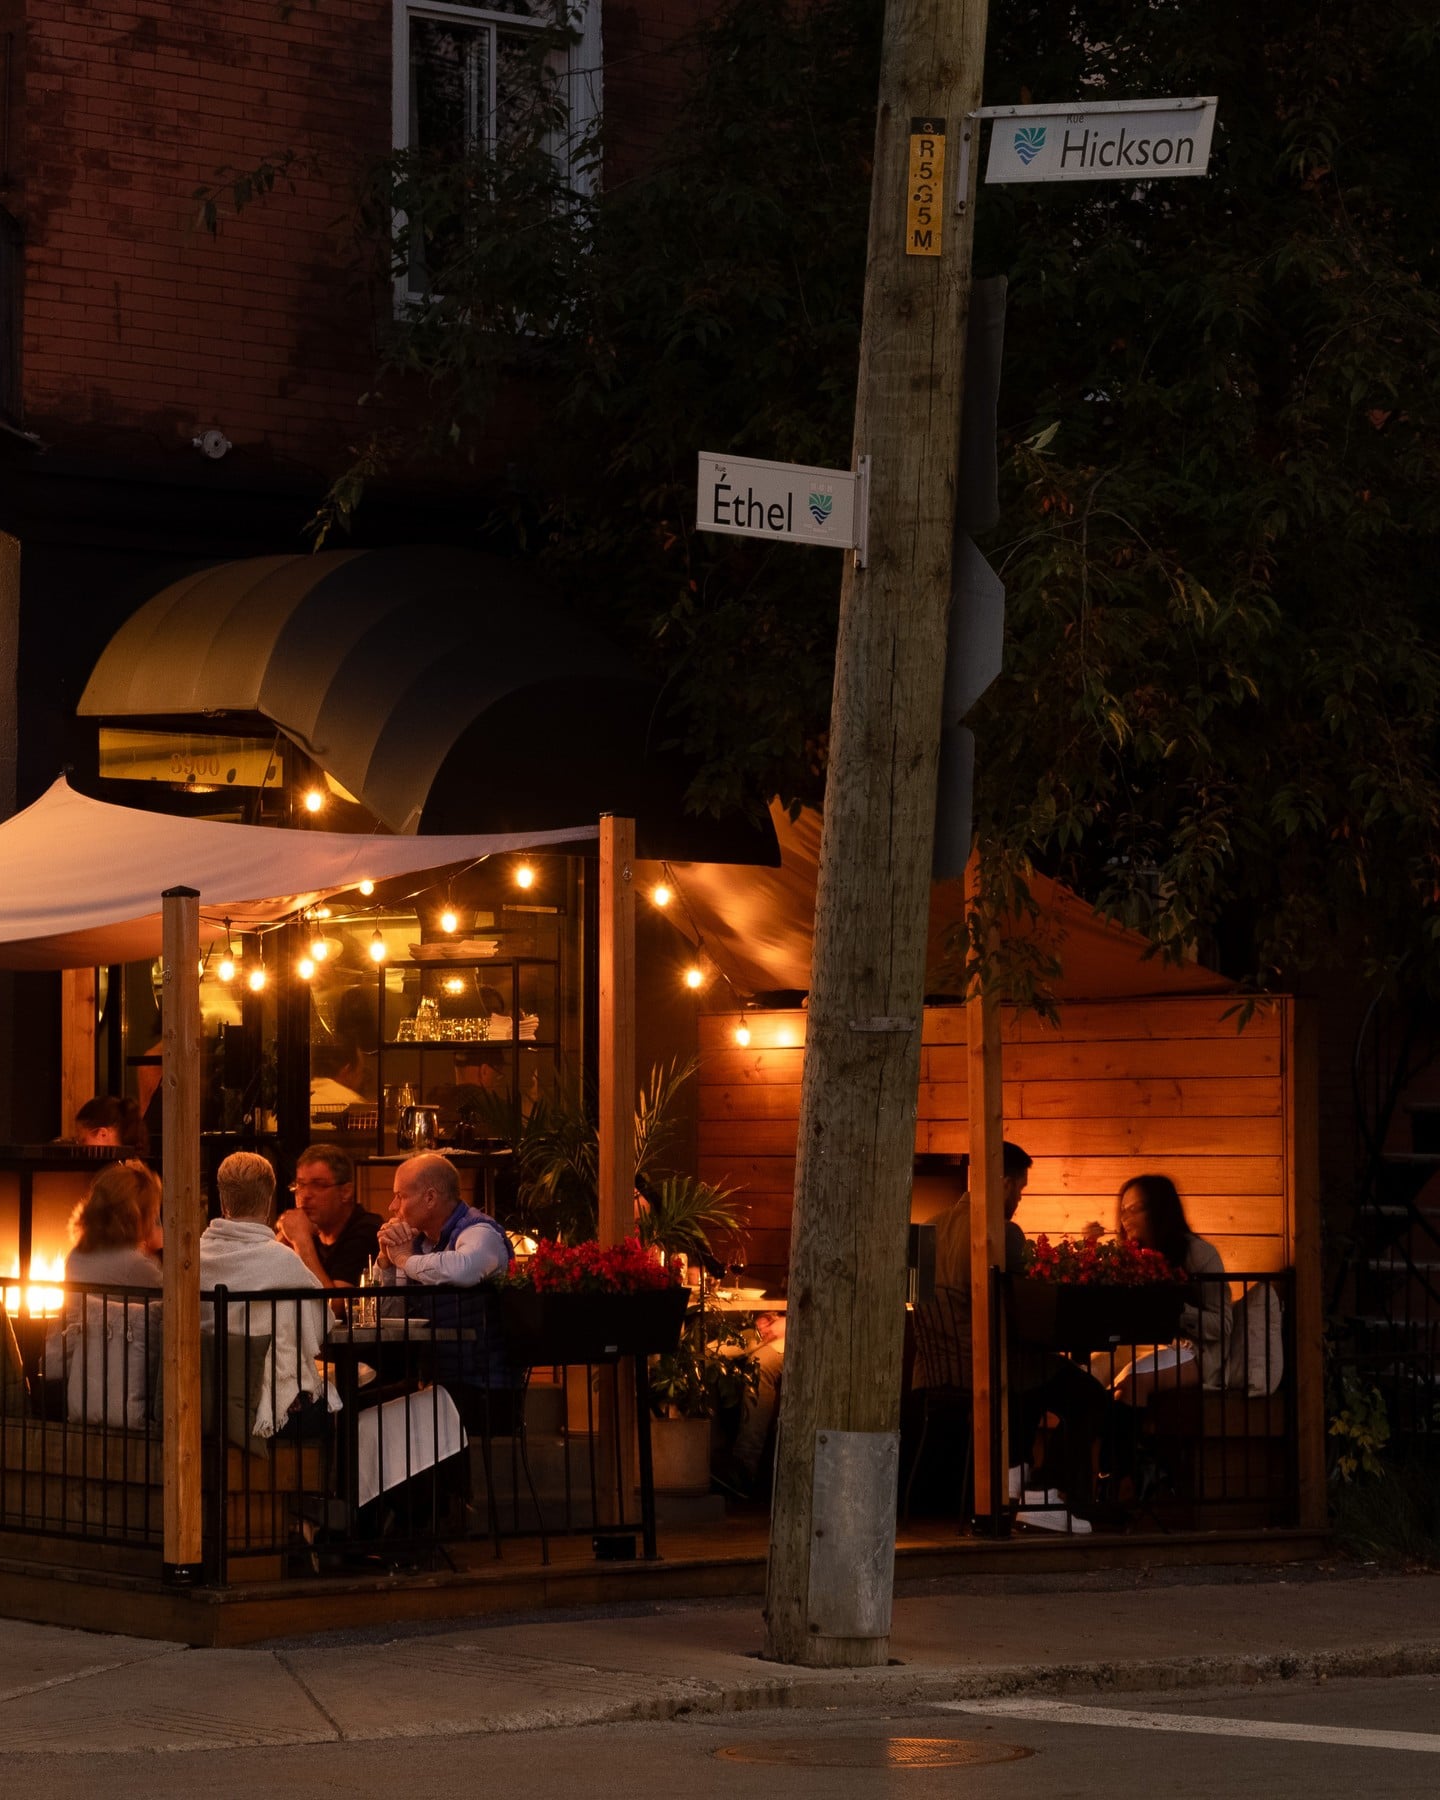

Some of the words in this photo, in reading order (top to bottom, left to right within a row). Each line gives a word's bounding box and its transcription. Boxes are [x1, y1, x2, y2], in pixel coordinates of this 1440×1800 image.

[1066, 113, 1084, 124] Rue
[1060, 127, 1195, 168] Hickson
[714, 464, 726, 473] Rue
[714, 473, 793, 532] Éthel
